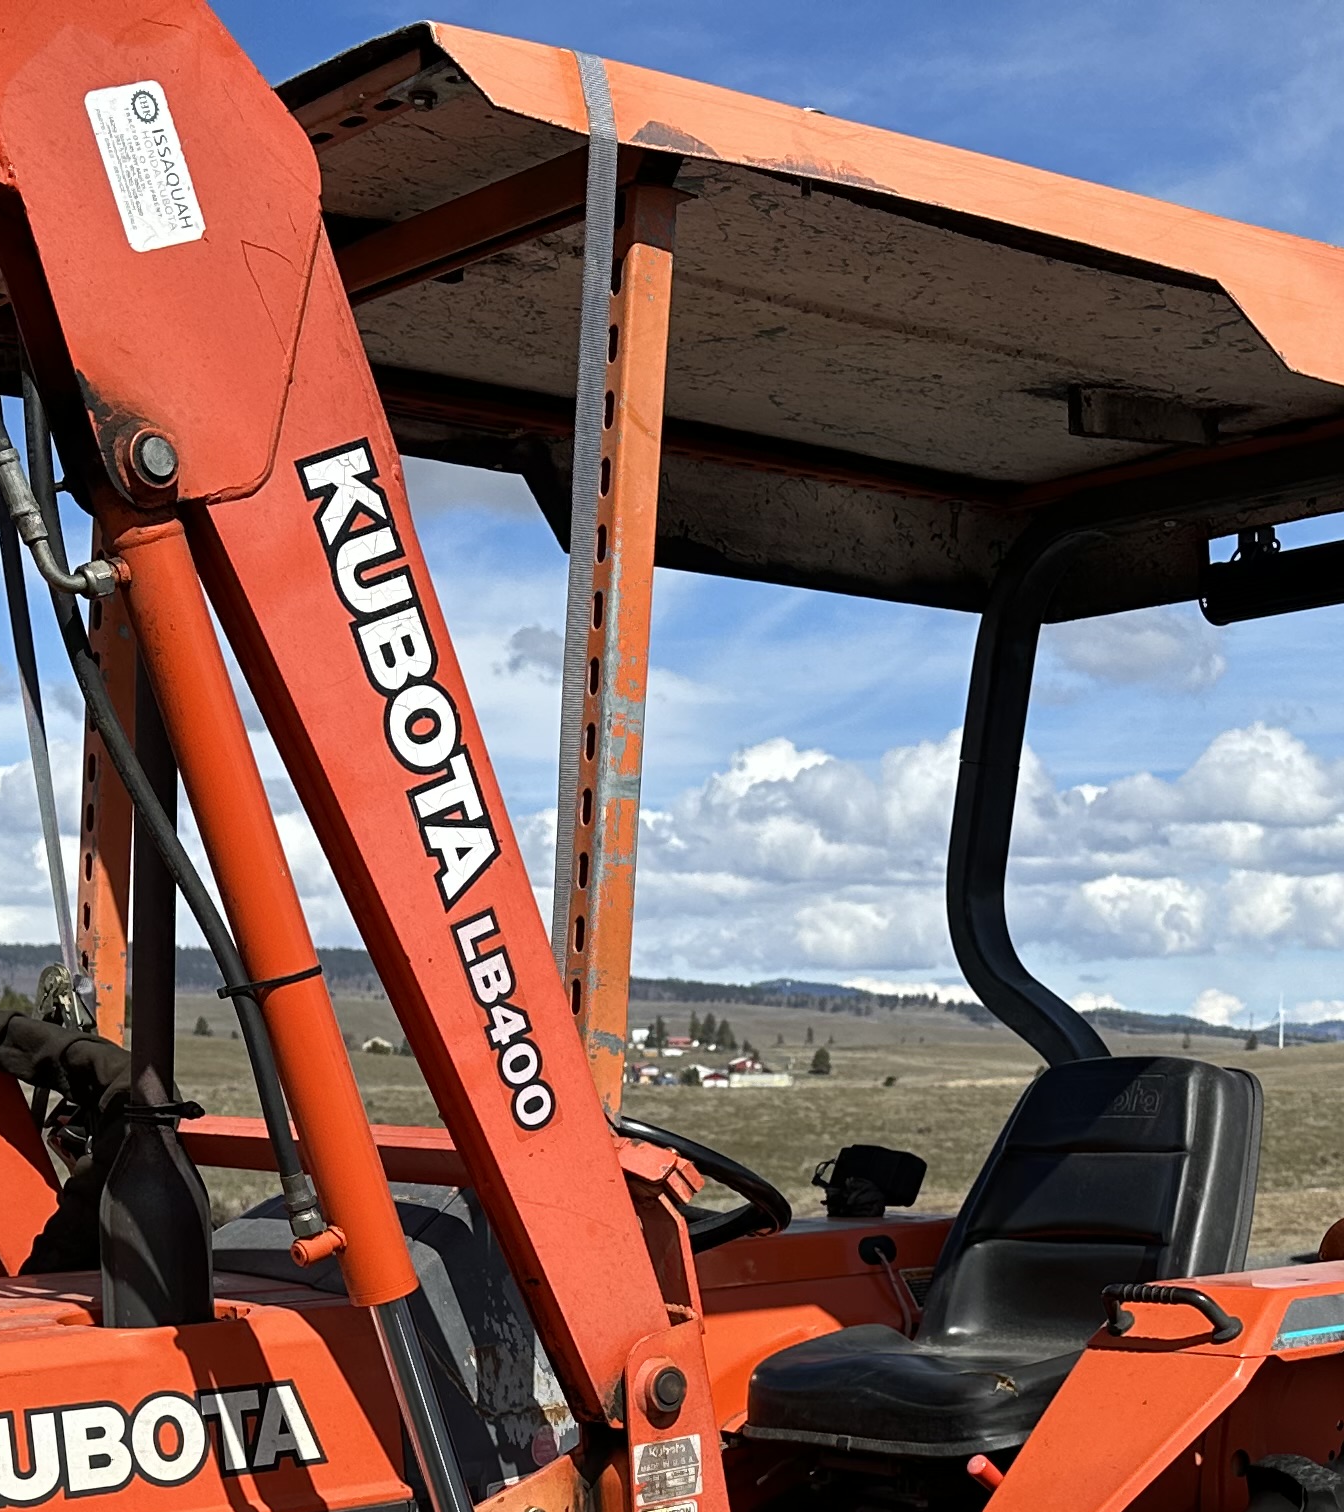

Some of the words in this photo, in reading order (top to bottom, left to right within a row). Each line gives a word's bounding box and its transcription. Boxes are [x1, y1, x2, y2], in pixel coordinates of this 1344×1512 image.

[141, 130, 162, 178] HONDA
[157, 180, 178, 232] KUBOTA
[152, 128, 194, 229] ISSAQUAH
[296, 438, 501, 910] KUBOTA
[452, 908, 555, 1131] LB400
[649, 1443, 686, 1458] Kubota
